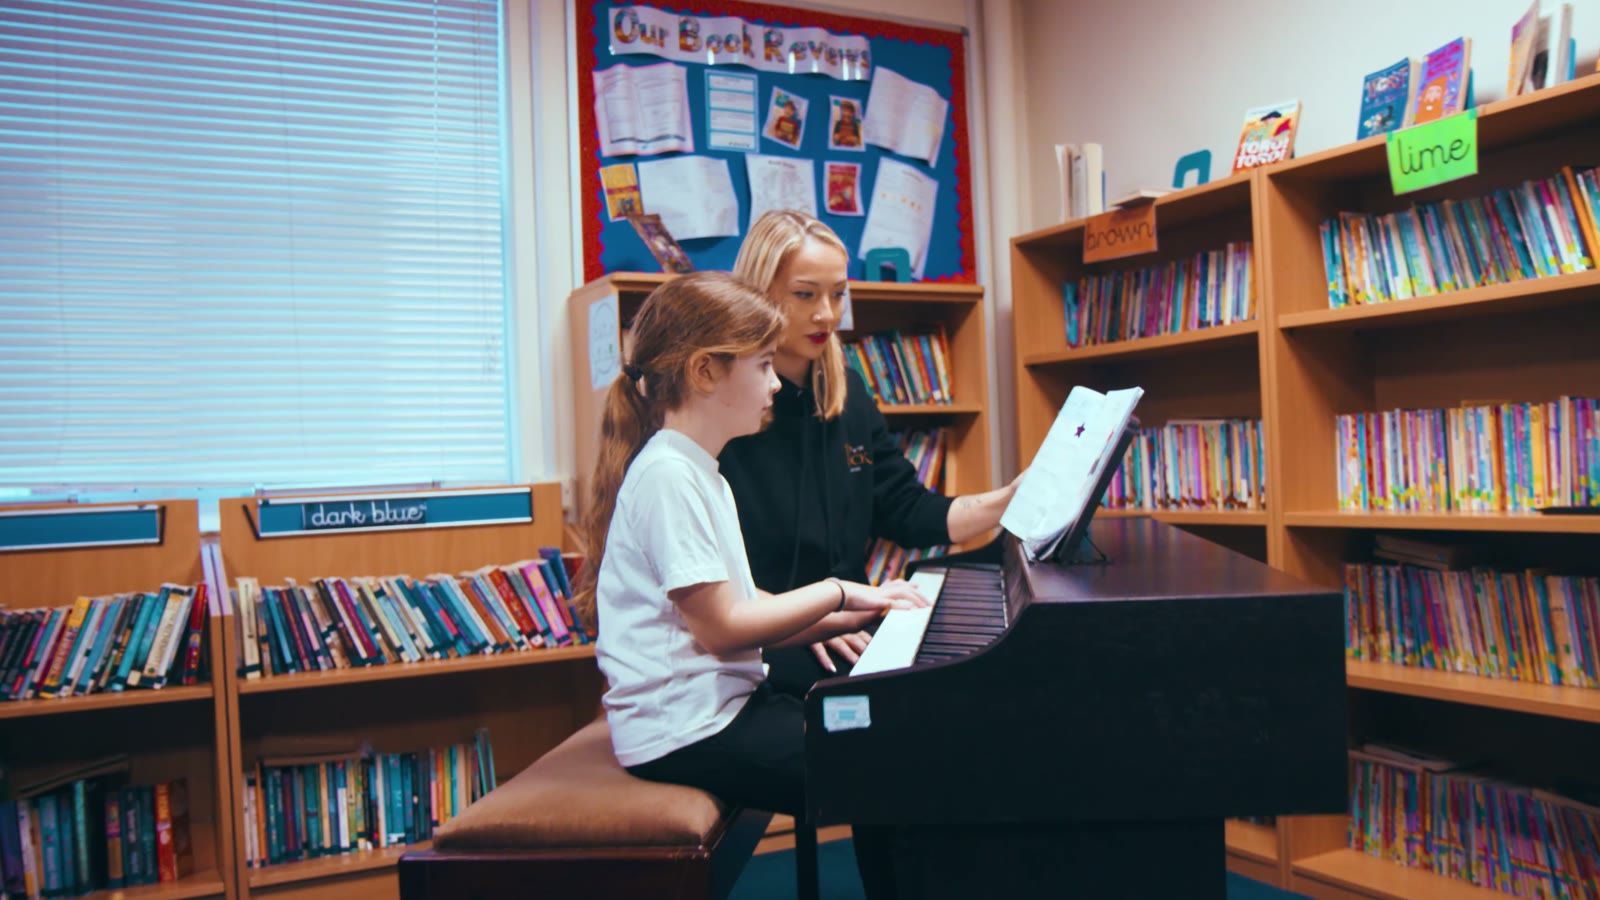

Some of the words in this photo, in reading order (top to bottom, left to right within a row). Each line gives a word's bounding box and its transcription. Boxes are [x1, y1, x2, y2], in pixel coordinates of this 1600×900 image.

[614, 8, 668, 48] Our
[679, 16, 755, 58] Book
[1397, 138, 1471, 175] lime
[1087, 221, 1154, 250] brown
[311, 503, 366, 526] dark
[371, 500, 424, 523] blue
